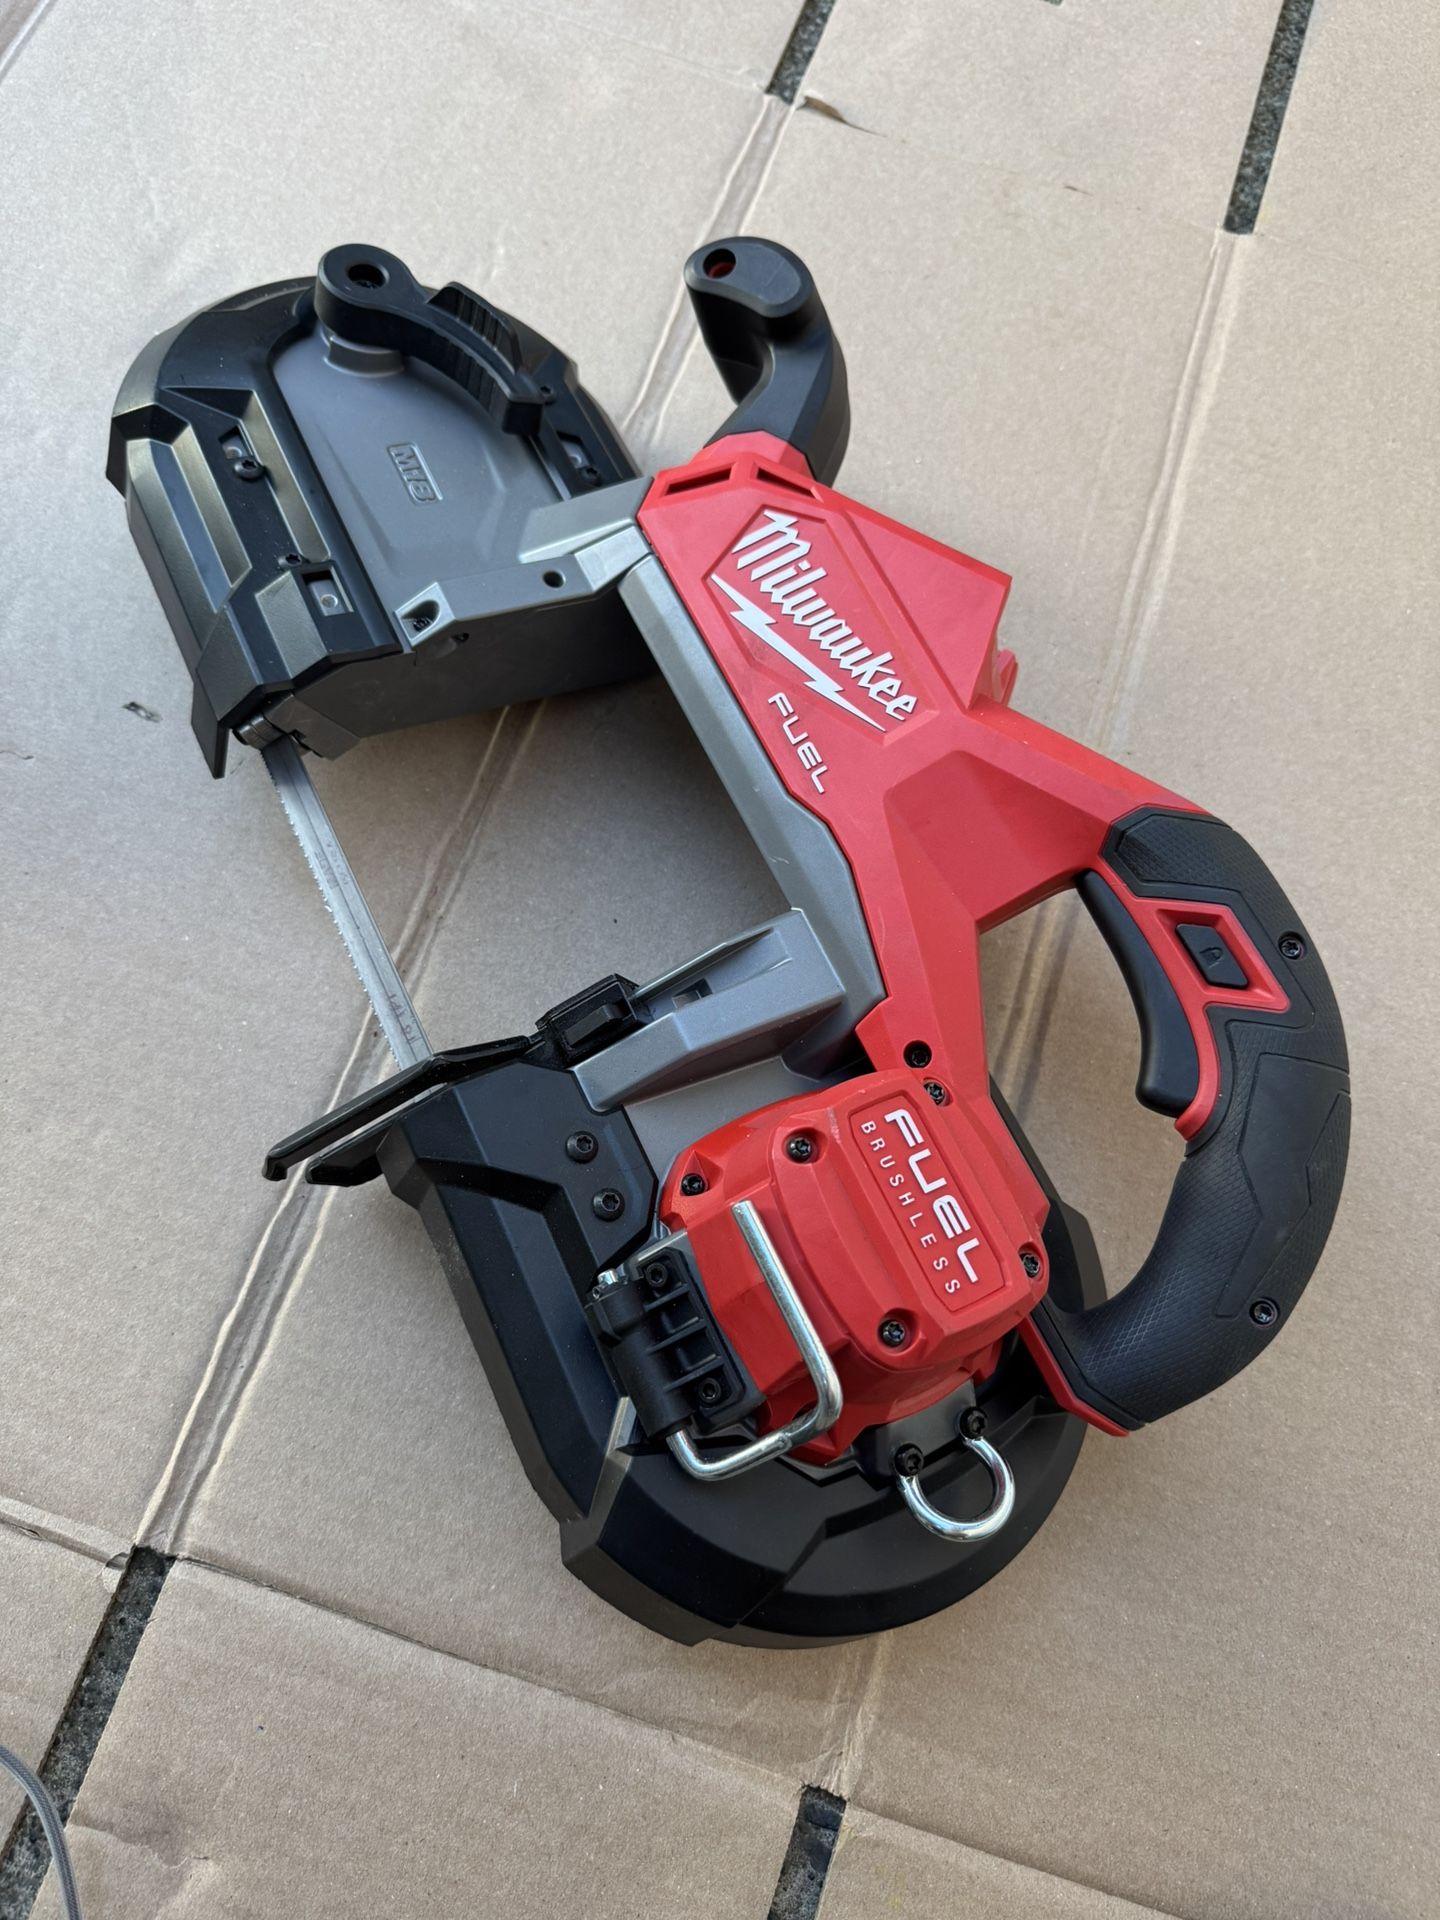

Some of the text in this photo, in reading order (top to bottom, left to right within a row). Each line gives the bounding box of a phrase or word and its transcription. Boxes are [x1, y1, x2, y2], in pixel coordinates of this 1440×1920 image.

[389, 447, 438, 502] M18
[731, 509, 918, 721] Milwaukee
[767, 691, 828, 794] FUEL
[861, 1120, 961, 1294] BRUSHLESS
[884, 1108, 980, 1283] FUEL
